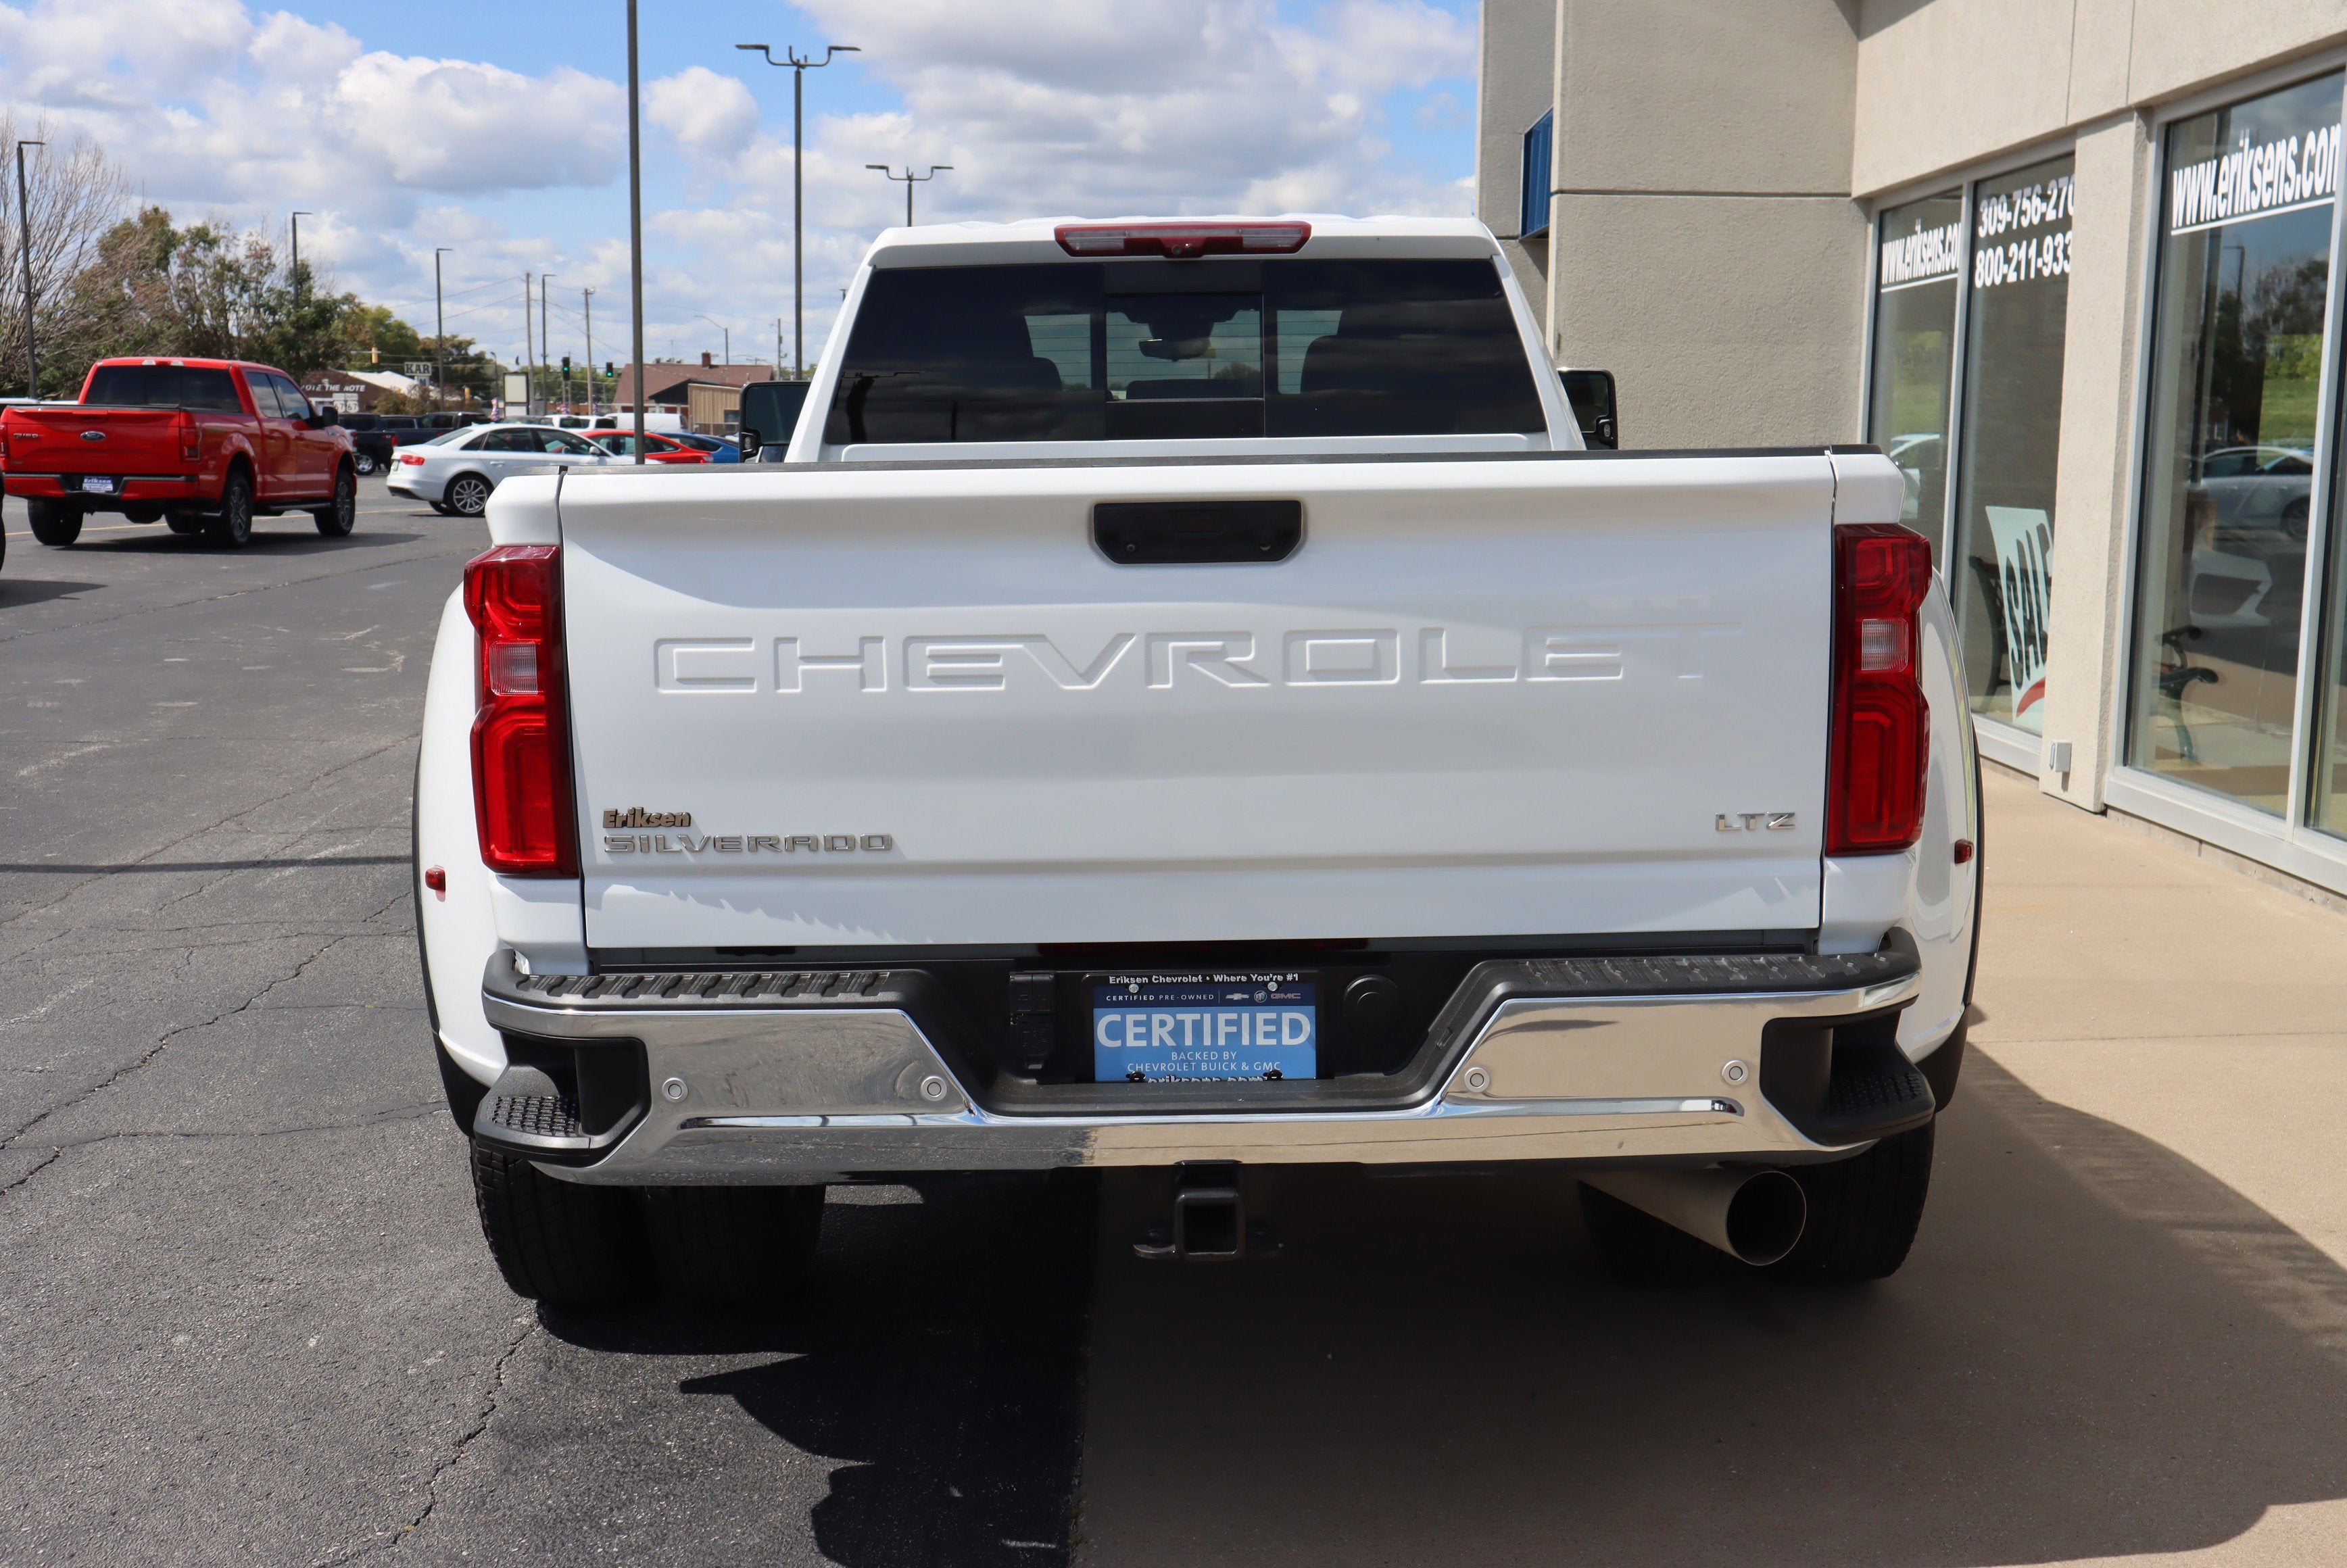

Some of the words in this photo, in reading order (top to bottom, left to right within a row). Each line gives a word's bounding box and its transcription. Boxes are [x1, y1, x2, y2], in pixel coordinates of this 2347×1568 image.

[406, 364, 430, 374] KAR
[654, 622, 1744, 695] CHEVROLET
[603, 806, 691, 828] Eriksen
[1714, 811, 1795, 831] LTZ
[604, 833, 892, 853] SILVERADO
[1109, 975, 1148, 984] Eriksen
[1152, 974, 1203, 983] Chevrolet
[1213, 974, 1247, 982] Where
[1250, 973, 1283, 982] You're
[1096, 1012, 1311, 1048] CERTIFIED
[1171, 1052, 1218, 1060] BACKED
[1224, 1051, 1237, 1060] BY
[1128, 1062, 1196, 1072] CHEVROLET
[1201, 1062, 1237, 1071] BUICK
[1241, 1062, 1249, 1071] &
[1253, 1062, 1281, 1071] GMC
